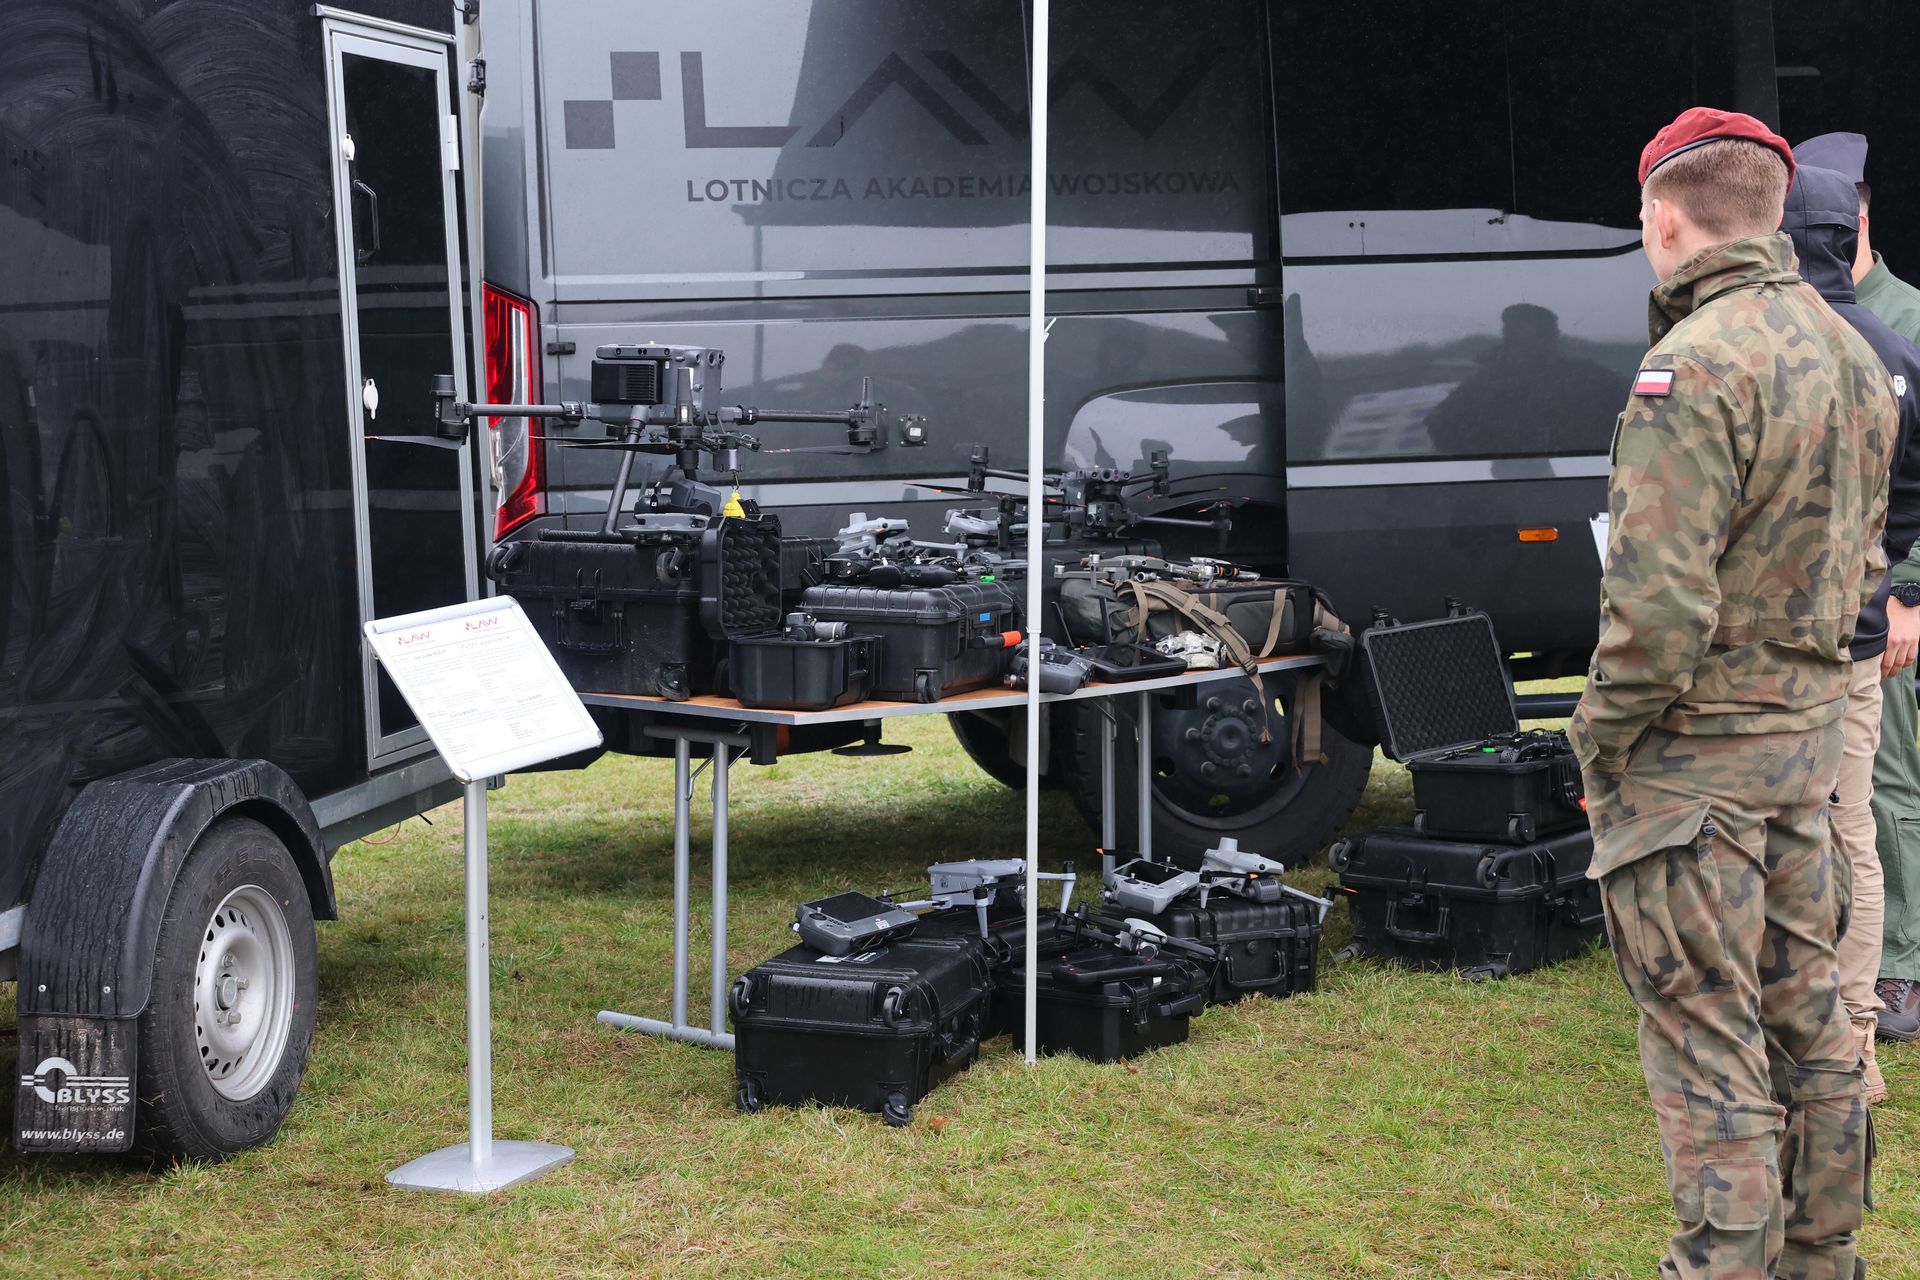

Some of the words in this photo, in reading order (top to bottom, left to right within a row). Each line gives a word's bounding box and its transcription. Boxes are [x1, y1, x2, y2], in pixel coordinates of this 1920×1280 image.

[687, 176, 853, 202] LOTNICZA
[1048, 171, 1241, 196] WOJSKOWA
[57, 1088, 130, 1104] BLYSS
[21, 1128, 125, 1142] www.blyss.de
